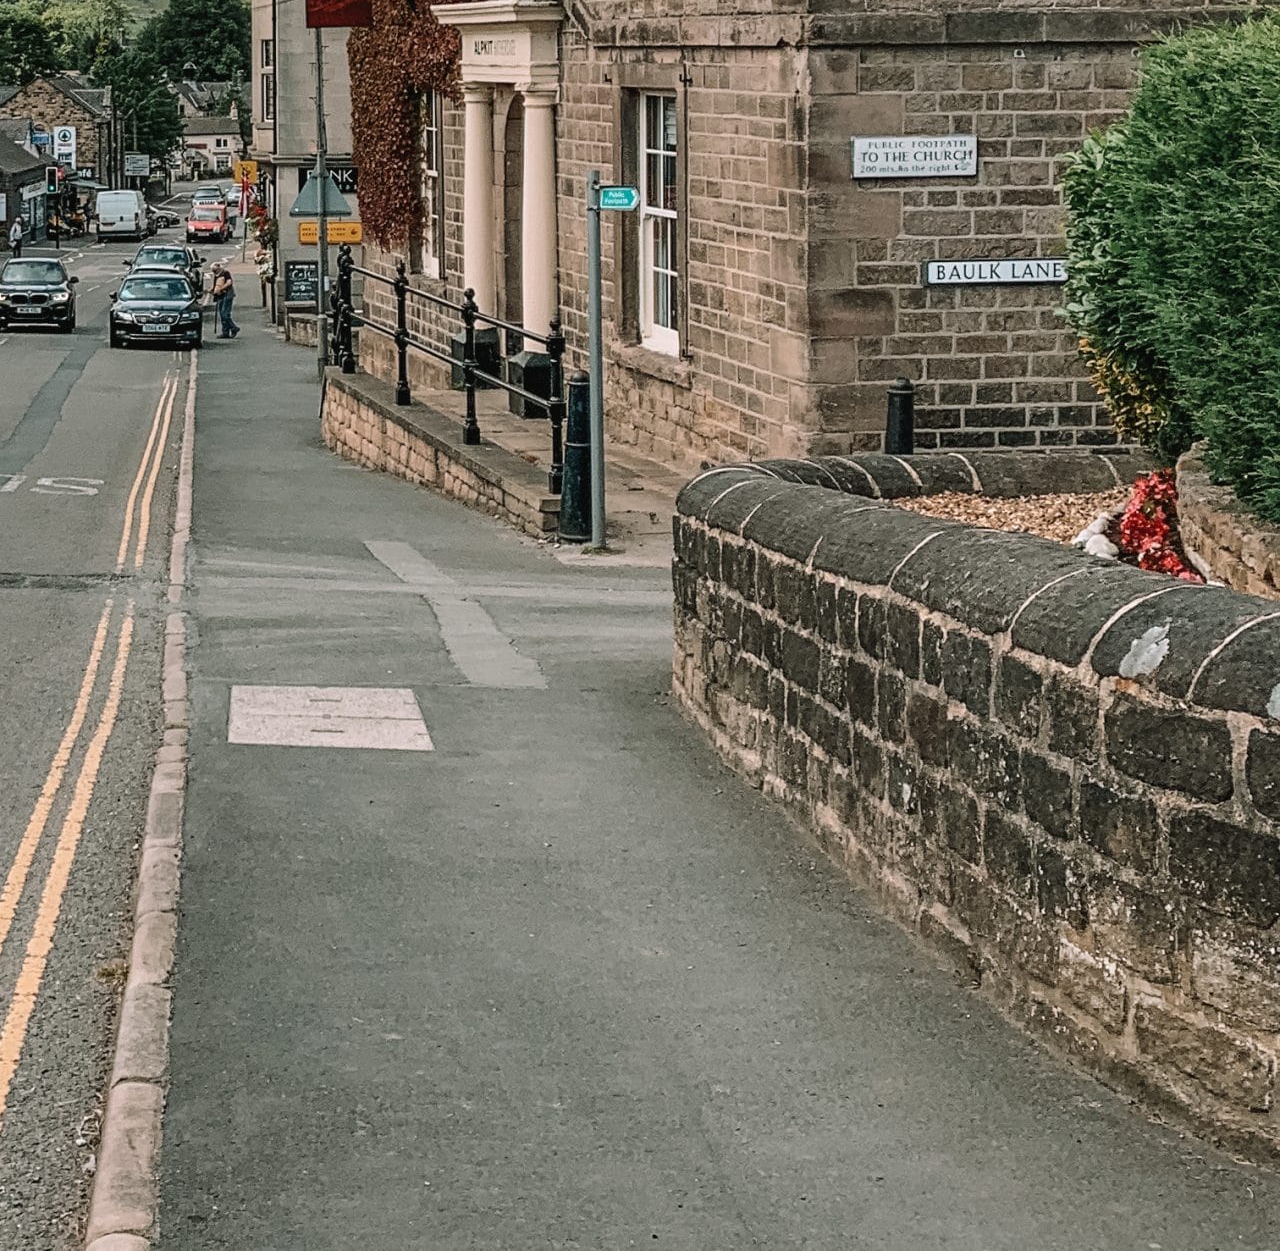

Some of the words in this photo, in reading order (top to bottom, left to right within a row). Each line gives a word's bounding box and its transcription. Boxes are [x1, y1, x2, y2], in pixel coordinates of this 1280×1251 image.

[474, 40, 493, 55] ALPKIT
[868, 141, 903, 149] PUBLIC
[912, 140, 967, 148] FOOTPATH
[861, 152, 878, 163] TO
[883, 151, 909, 162] THE
[913, 149, 973, 161] CHURCH
[937, 263, 1001, 280] BAULK
[1012, 263, 1062, 279] LANE
